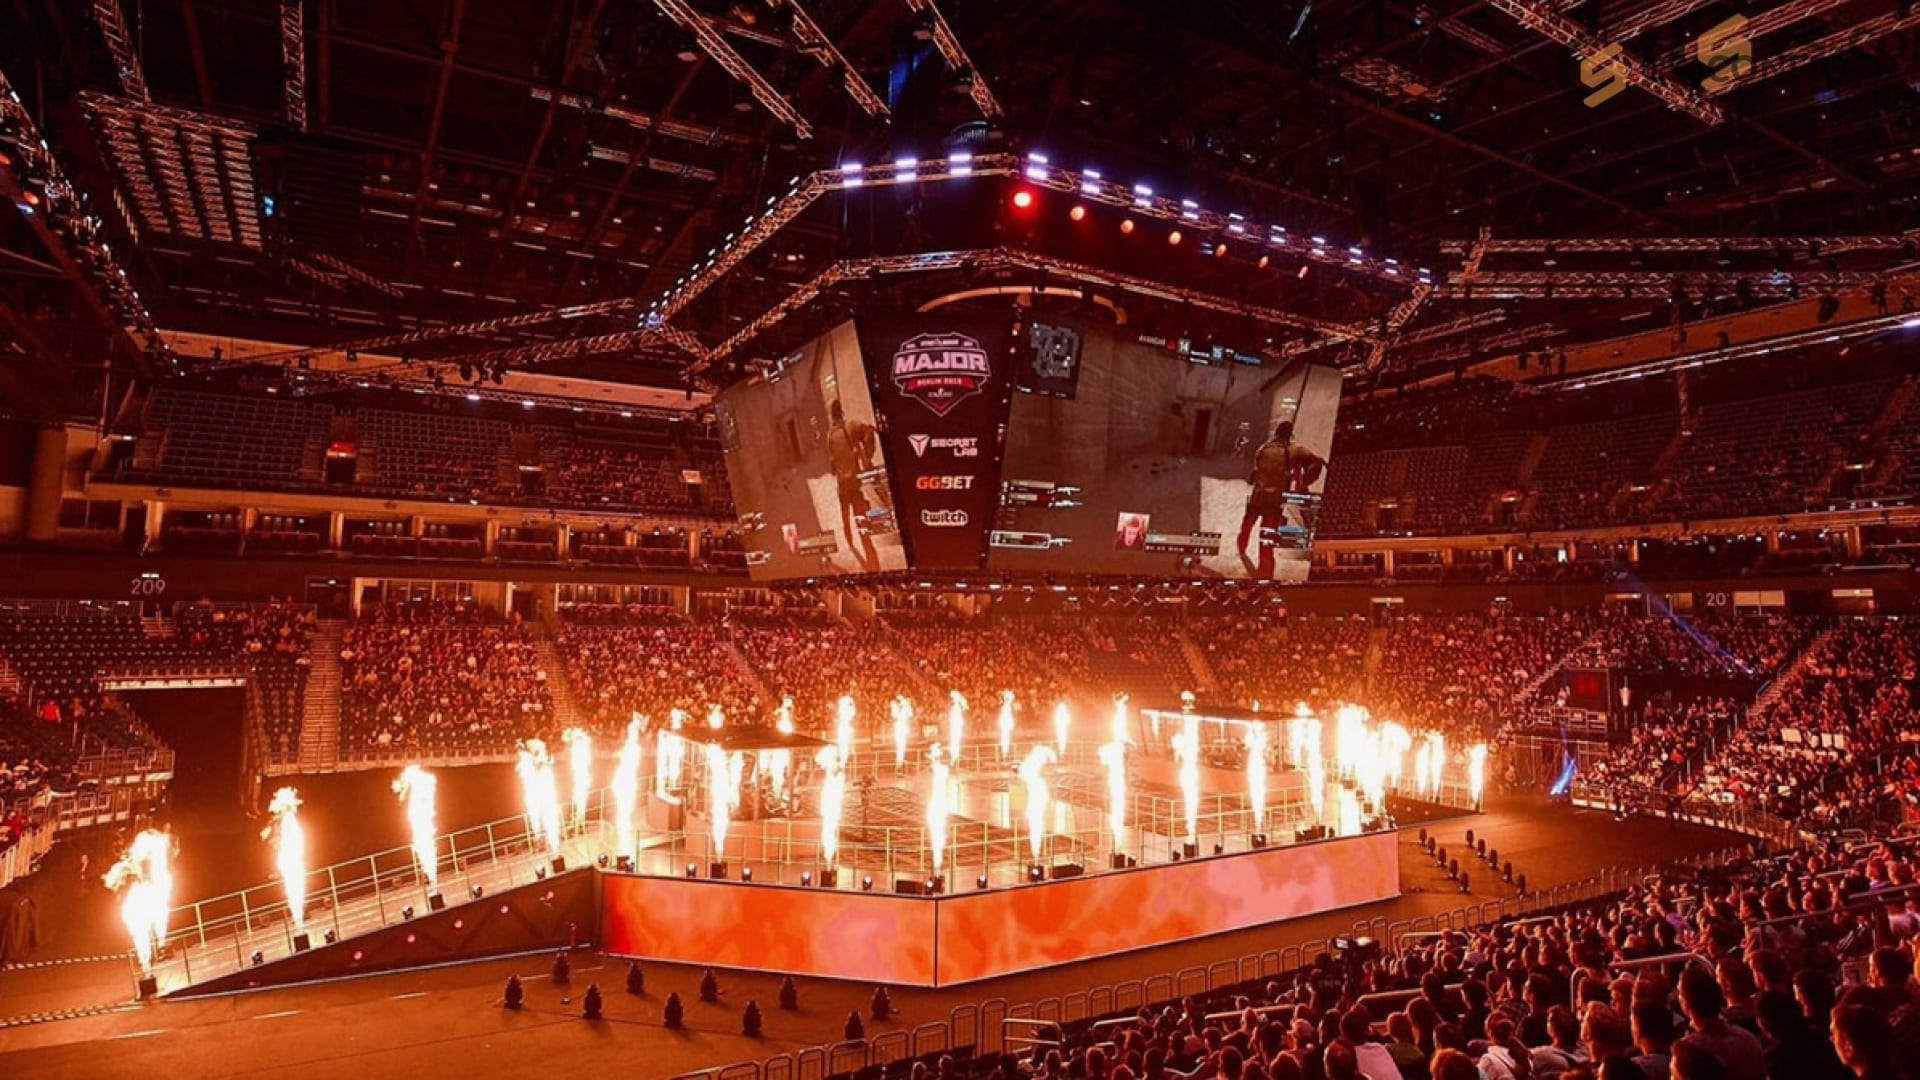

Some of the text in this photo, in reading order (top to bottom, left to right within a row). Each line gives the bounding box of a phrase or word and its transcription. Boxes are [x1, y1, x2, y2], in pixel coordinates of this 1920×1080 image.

[895, 351, 987, 374] MAJOR
[921, 509, 968, 526] twitch
[130, 578, 166, 595] 209
[1705, 592, 1730, 607] 20
